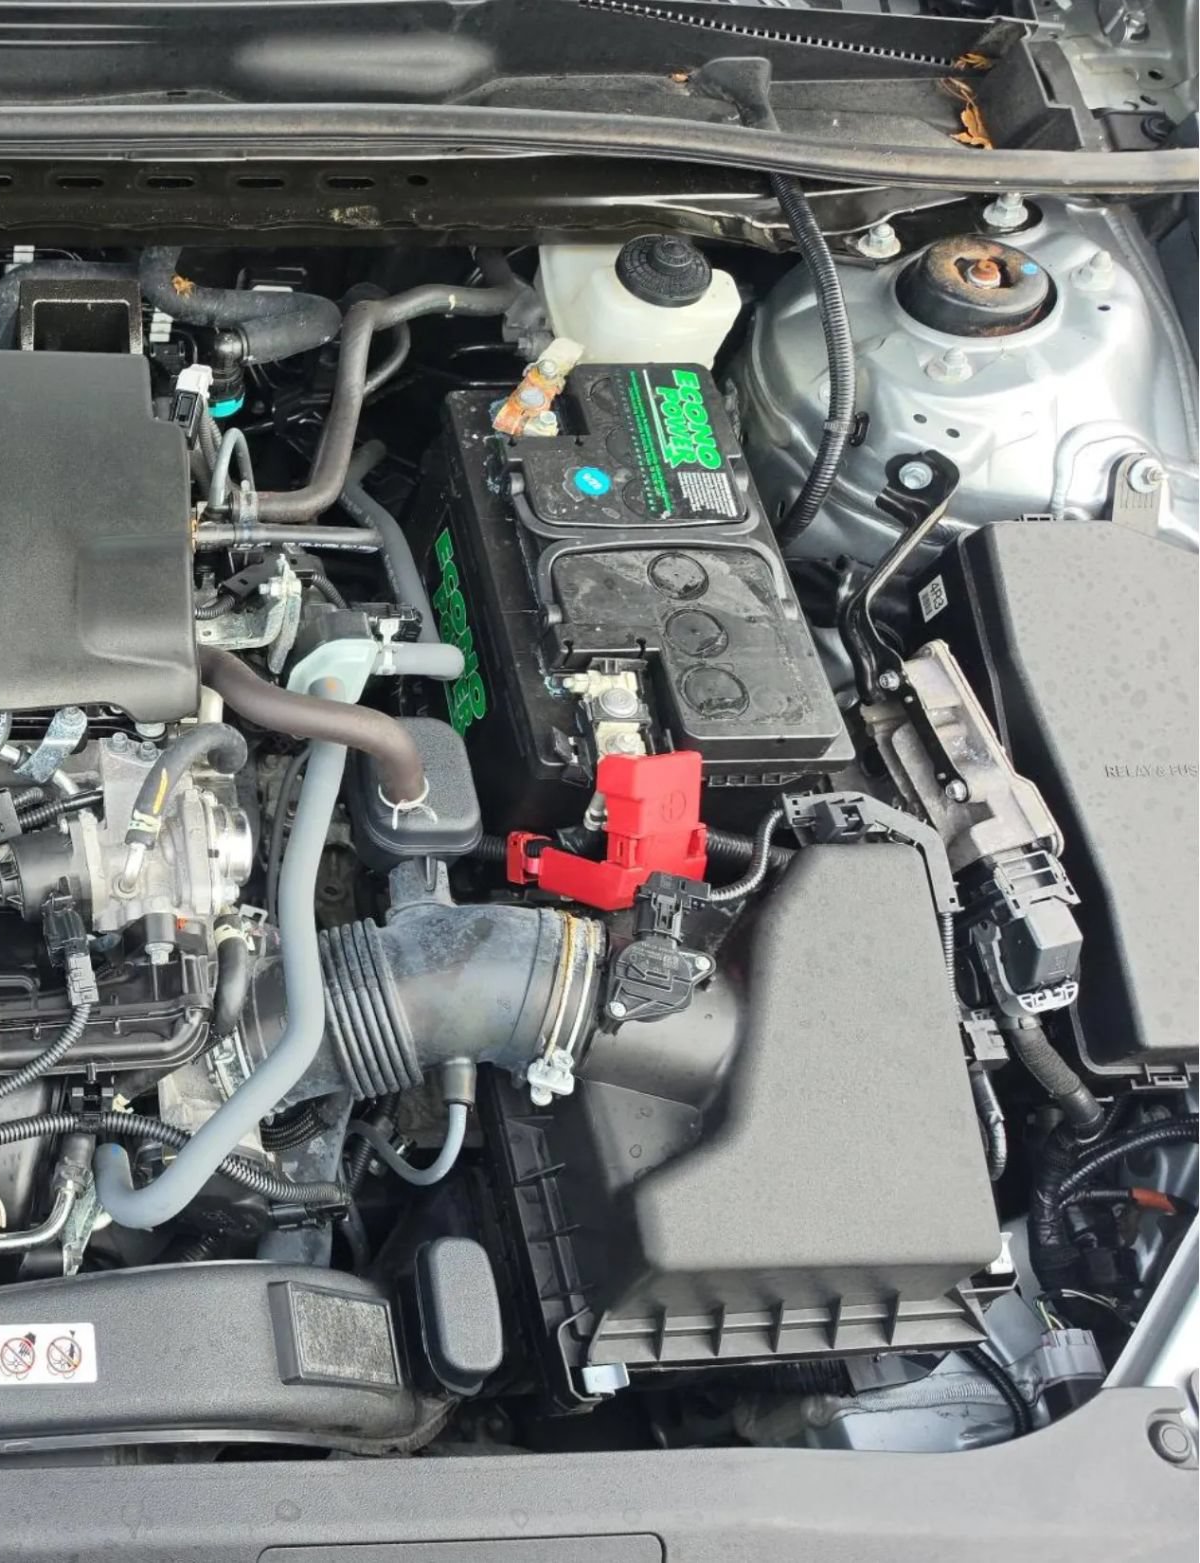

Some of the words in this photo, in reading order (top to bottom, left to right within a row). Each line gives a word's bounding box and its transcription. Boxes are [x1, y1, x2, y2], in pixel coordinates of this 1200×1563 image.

[655, 386, 696, 469] POWER
[672, 369, 721, 469] ECONO
[433, 582, 474, 738] POER
[435, 527, 485, 719] ECONO
[1104, 763, 1151, 778] RELAY
